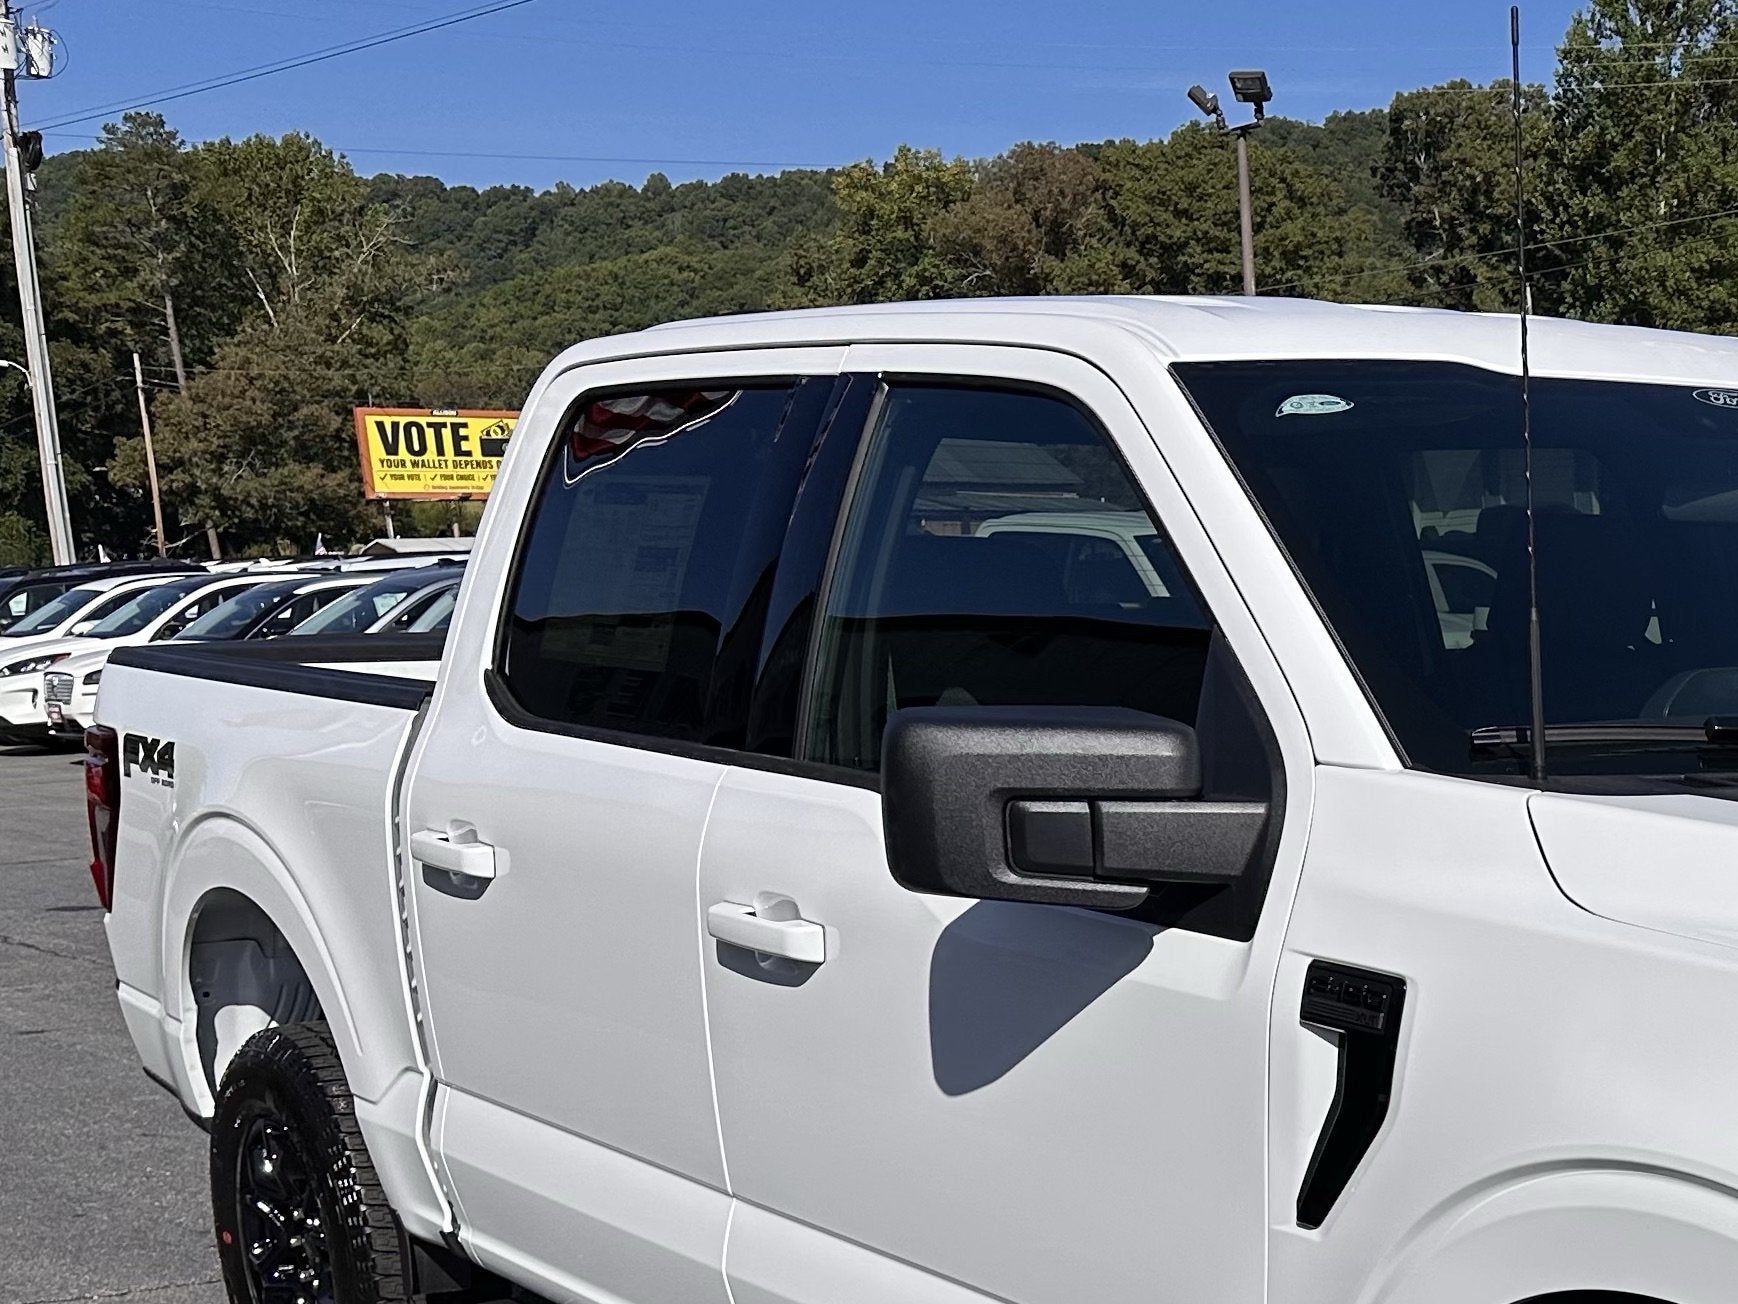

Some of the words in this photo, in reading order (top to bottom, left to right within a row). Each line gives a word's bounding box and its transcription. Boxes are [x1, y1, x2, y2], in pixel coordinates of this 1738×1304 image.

[374, 420, 473, 457] VOTE
[379, 458, 407, 469] YOUR
[410, 459, 449, 469] WALLET
[452, 459, 494, 470] DEPENDS
[123, 733, 175, 779] FX4
